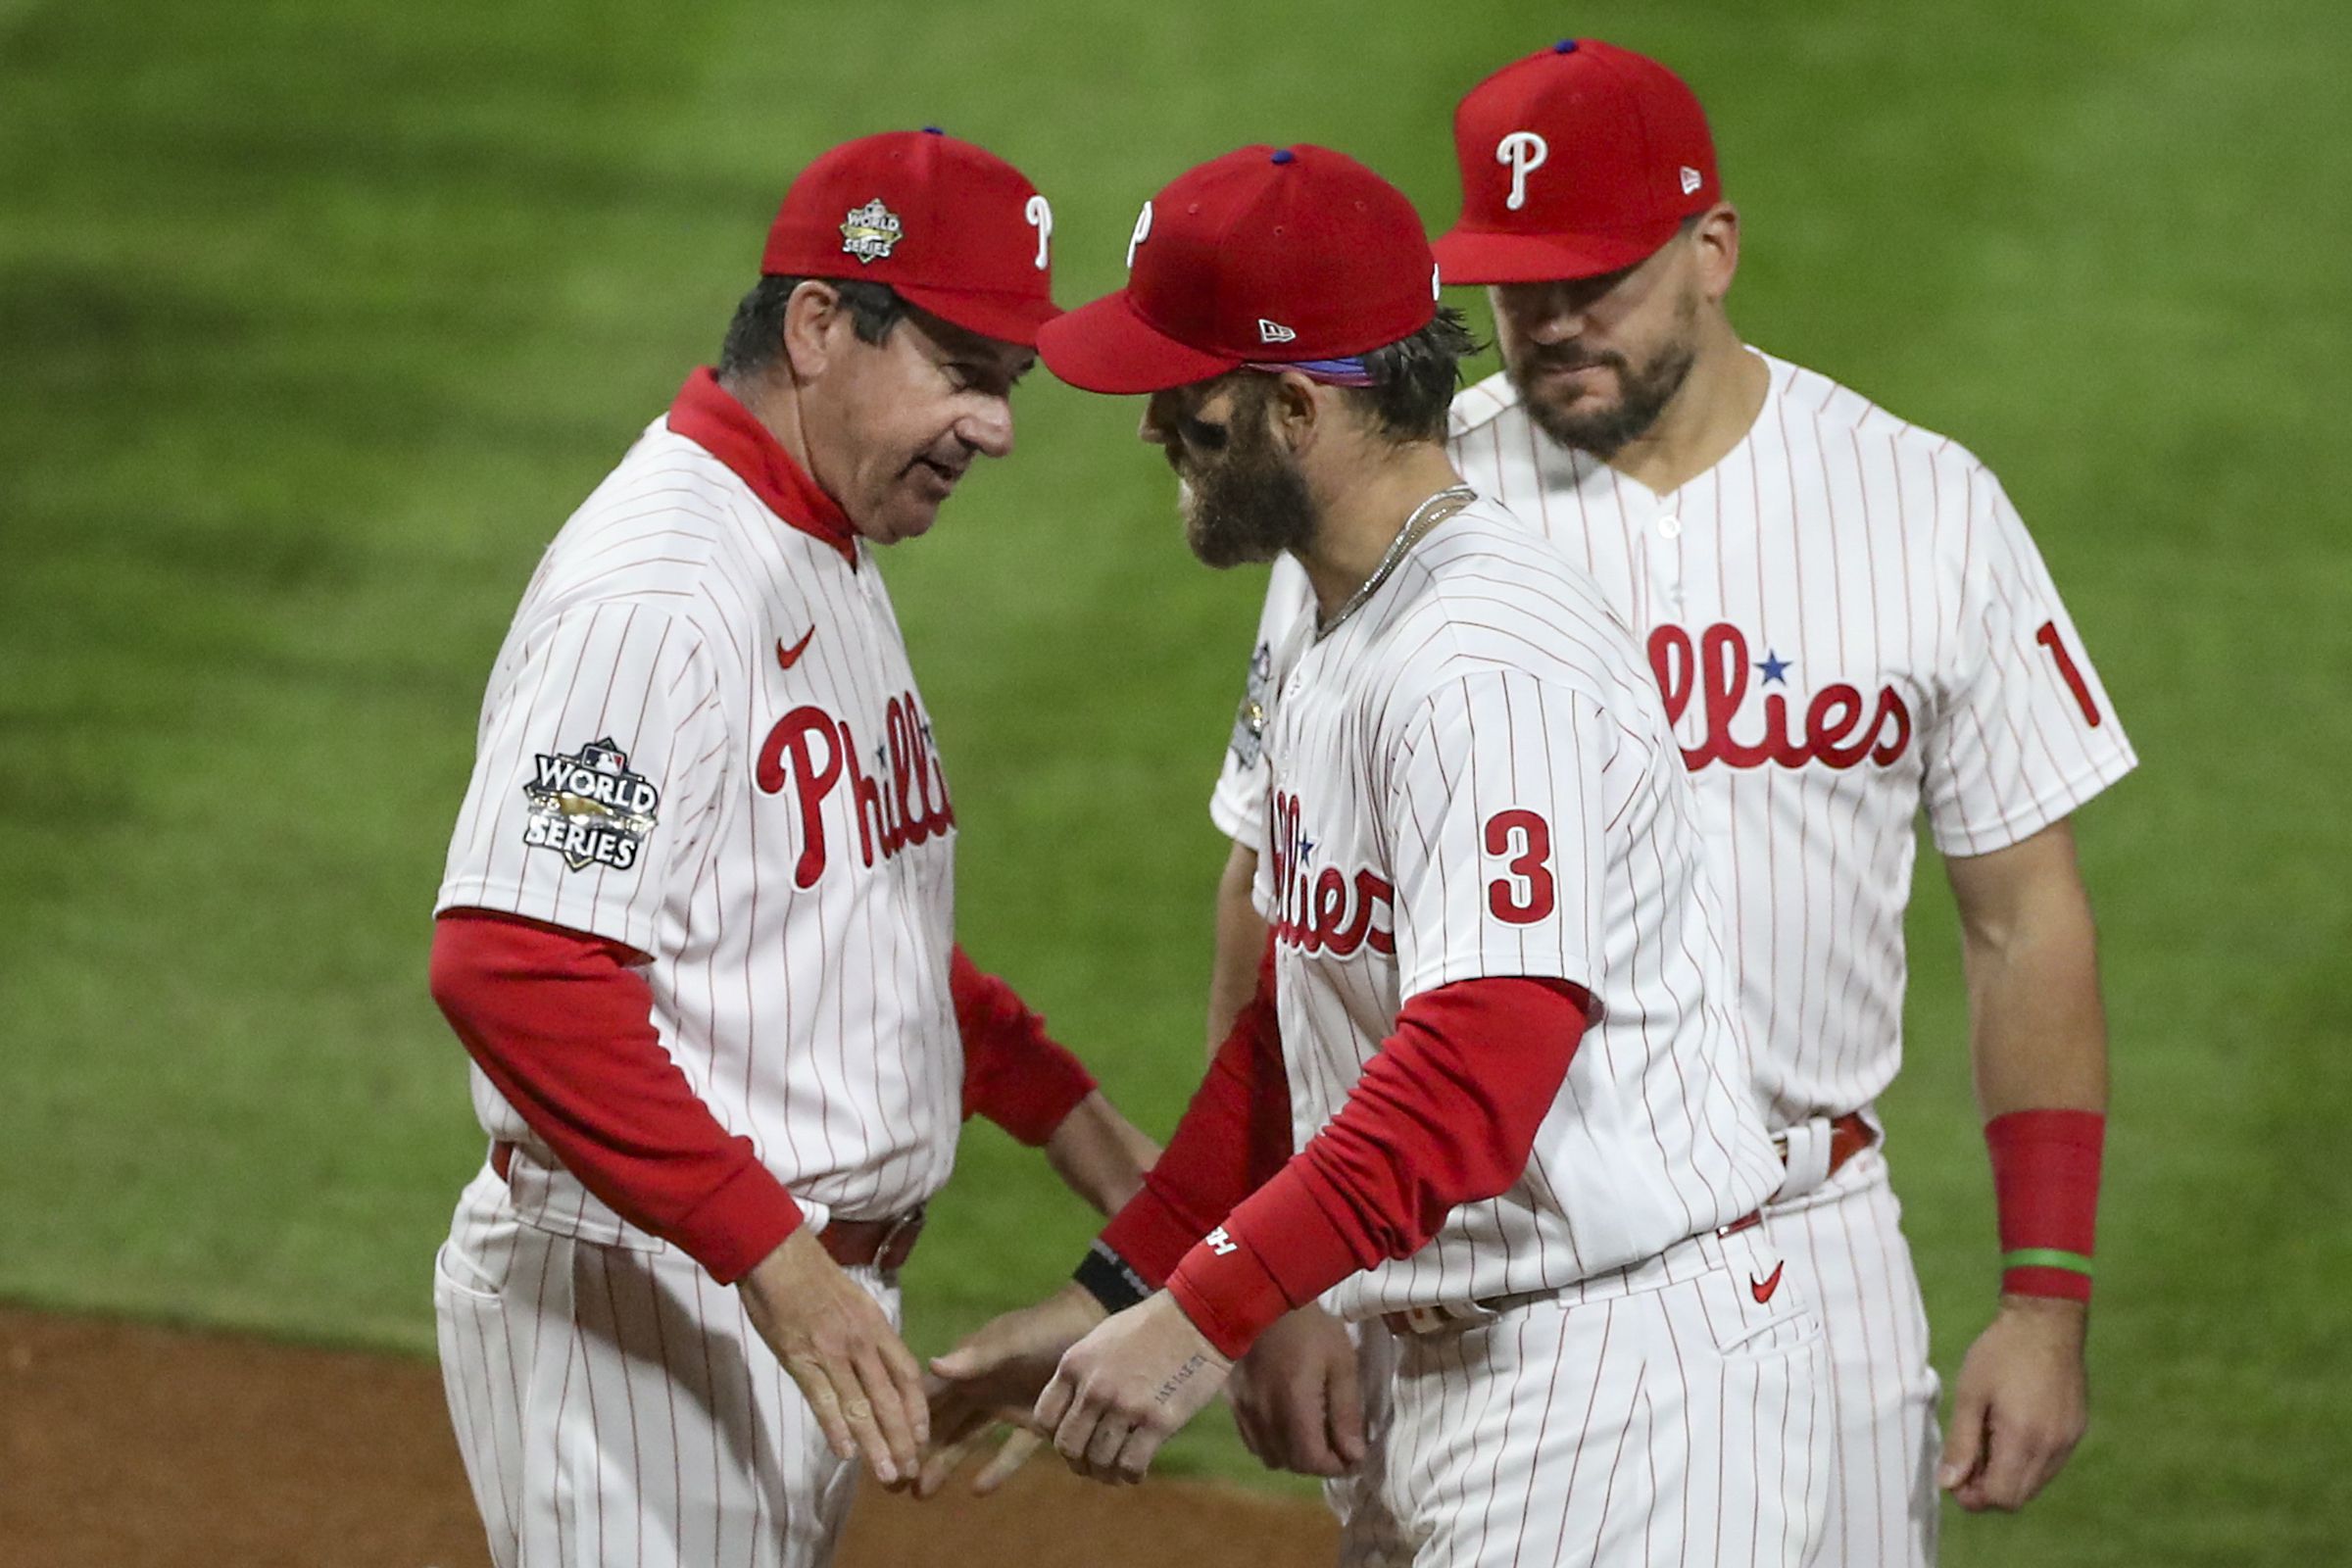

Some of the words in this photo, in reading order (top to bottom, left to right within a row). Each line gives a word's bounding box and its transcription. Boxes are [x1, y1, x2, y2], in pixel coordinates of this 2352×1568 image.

[1496, 131, 1548, 210] P
[843, 238, 890, 257] SERIES
[847, 212, 900, 231] WORLD
[1026, 195, 1053, 270] P
[1647, 622, 1910, 772] llies
[2036, 620, 2100, 727] 1
[538, 756, 658, 814] WORLD
[525, 814, 636, 867] SERIES
[1271, 790, 1396, 956] llies
[1486, 809, 1554, 924] 3
